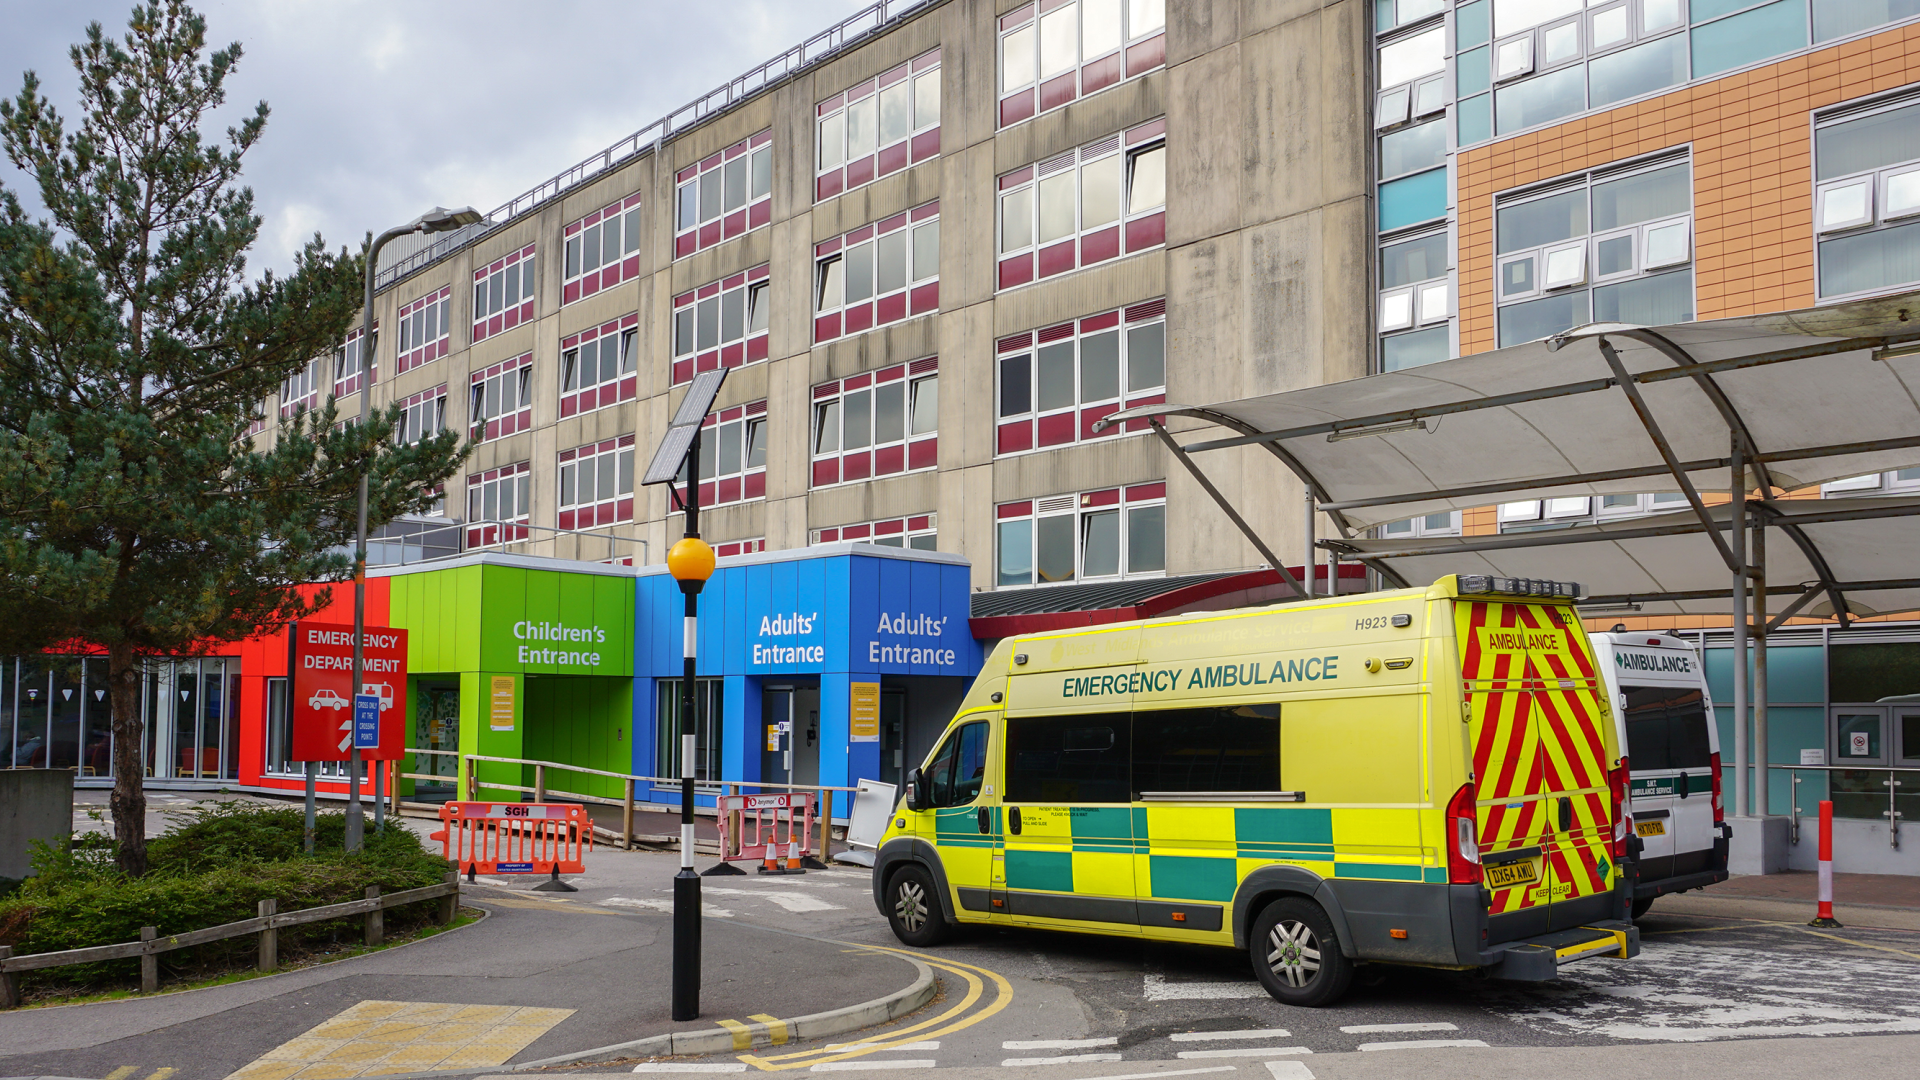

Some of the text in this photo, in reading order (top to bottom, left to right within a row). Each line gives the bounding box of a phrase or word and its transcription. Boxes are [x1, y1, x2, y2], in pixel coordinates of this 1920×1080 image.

[1355, 616, 1388, 631] H923
[1553, 612, 1573, 625] H923
[513, 620, 606, 643] Children's
[1489, 633, 1559, 650] AMBULANCE
[518, 645, 601, 666] Entrance
[753, 644, 824, 665] Entrance
[869, 641, 956, 665] Entrance
[304, 654, 400, 673] DEPARMENT
[1623, 653, 1691, 673] AMBULANCE
[1062, 655, 1339, 698] EMERGENCY AMBULANCE
[358, 701, 368, 709] CROSS
[359, 722, 375, 730] CROSSING
[361, 733, 373, 741] POINTS
[1631, 786, 1672, 796] AMBULANCE SERVICE
[505, 806, 530, 817] SGH
[1492, 865, 1533, 884] DX64 AWU
[1535, 884, 1570, 898] KEEP CLEAR
